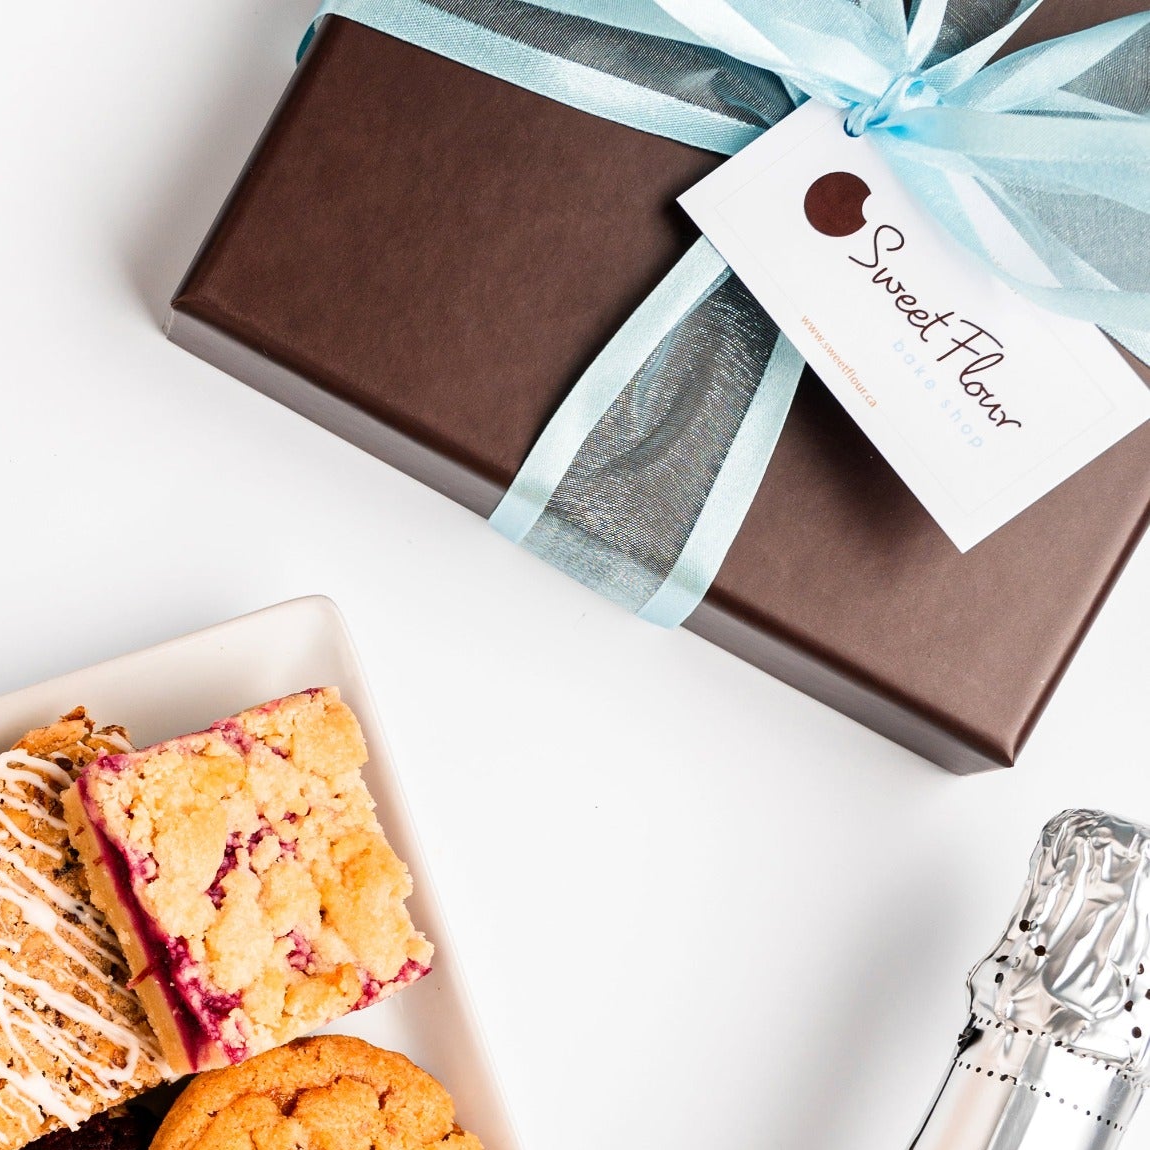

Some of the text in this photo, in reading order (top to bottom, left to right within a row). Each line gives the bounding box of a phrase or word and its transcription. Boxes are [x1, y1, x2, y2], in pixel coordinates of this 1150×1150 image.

[801, 315, 877, 408] www.sweetflour.ca
[848, 224, 1023, 428] Sweet Flour
[892, 340, 984, 448] bake shop
